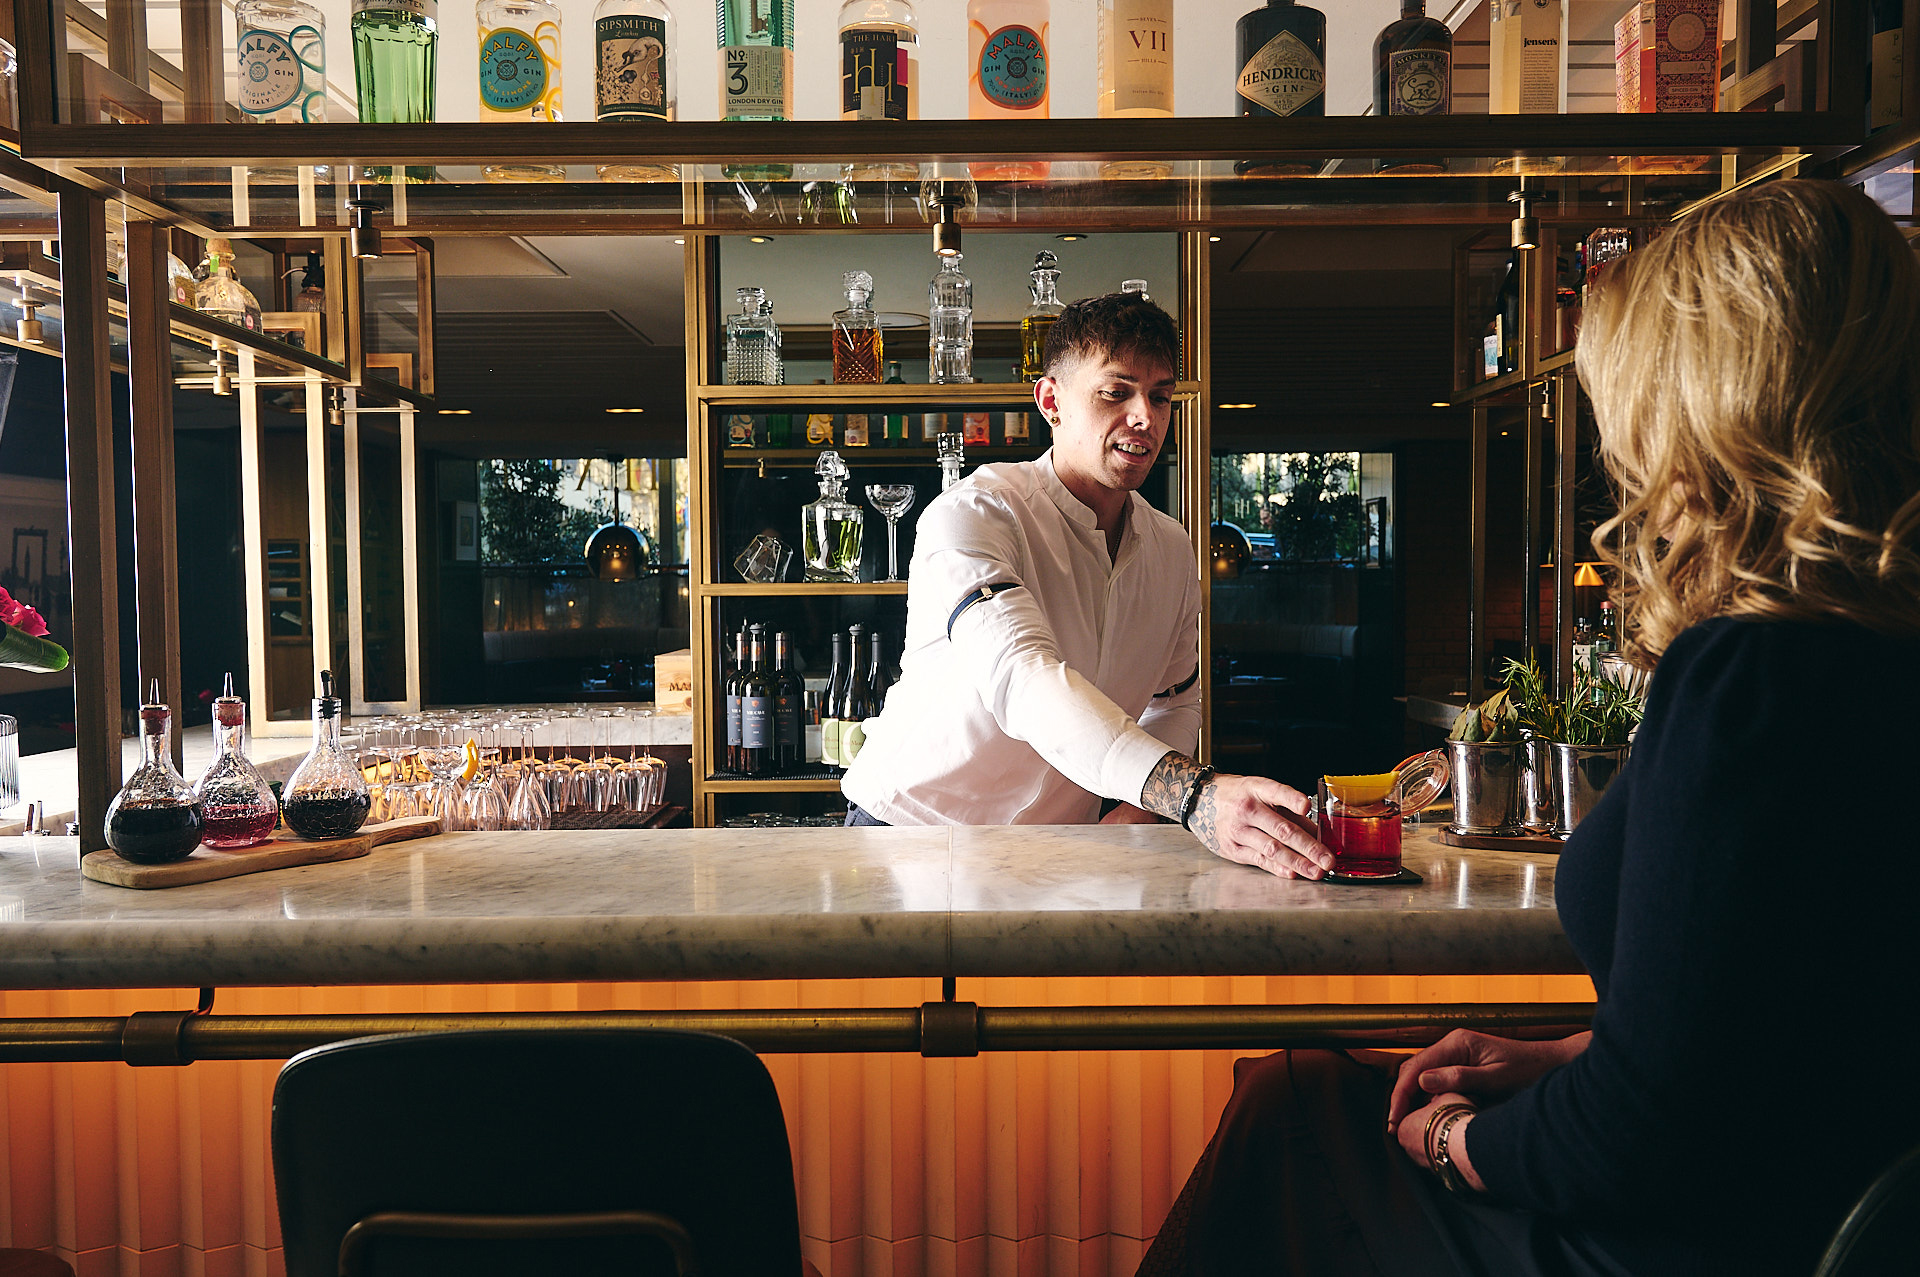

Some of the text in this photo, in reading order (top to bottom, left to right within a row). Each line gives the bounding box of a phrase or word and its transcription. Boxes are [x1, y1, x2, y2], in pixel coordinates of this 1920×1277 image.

[599, 19, 658, 32] SIPSMITH
[853, 34, 870, 43] THE
[1128, 30, 1167, 52] VII
[239, 38, 291, 66] MALFY
[482, 36, 538, 63] MALFY
[986, 33, 1044, 62] MALFY
[274, 69, 294, 77] GIN
[480, 69, 492, 77] GIN
[523, 68, 542, 76] GIN
[984, 64, 1001, 73] GIN
[1031, 66, 1045, 76] GIN
[727, 62, 749, 95] 3
[1242, 66, 1324, 87] HENDRICK'S
[501, 79, 532, 96] LIMONE
[1271, 84, 1299, 94] GIN
